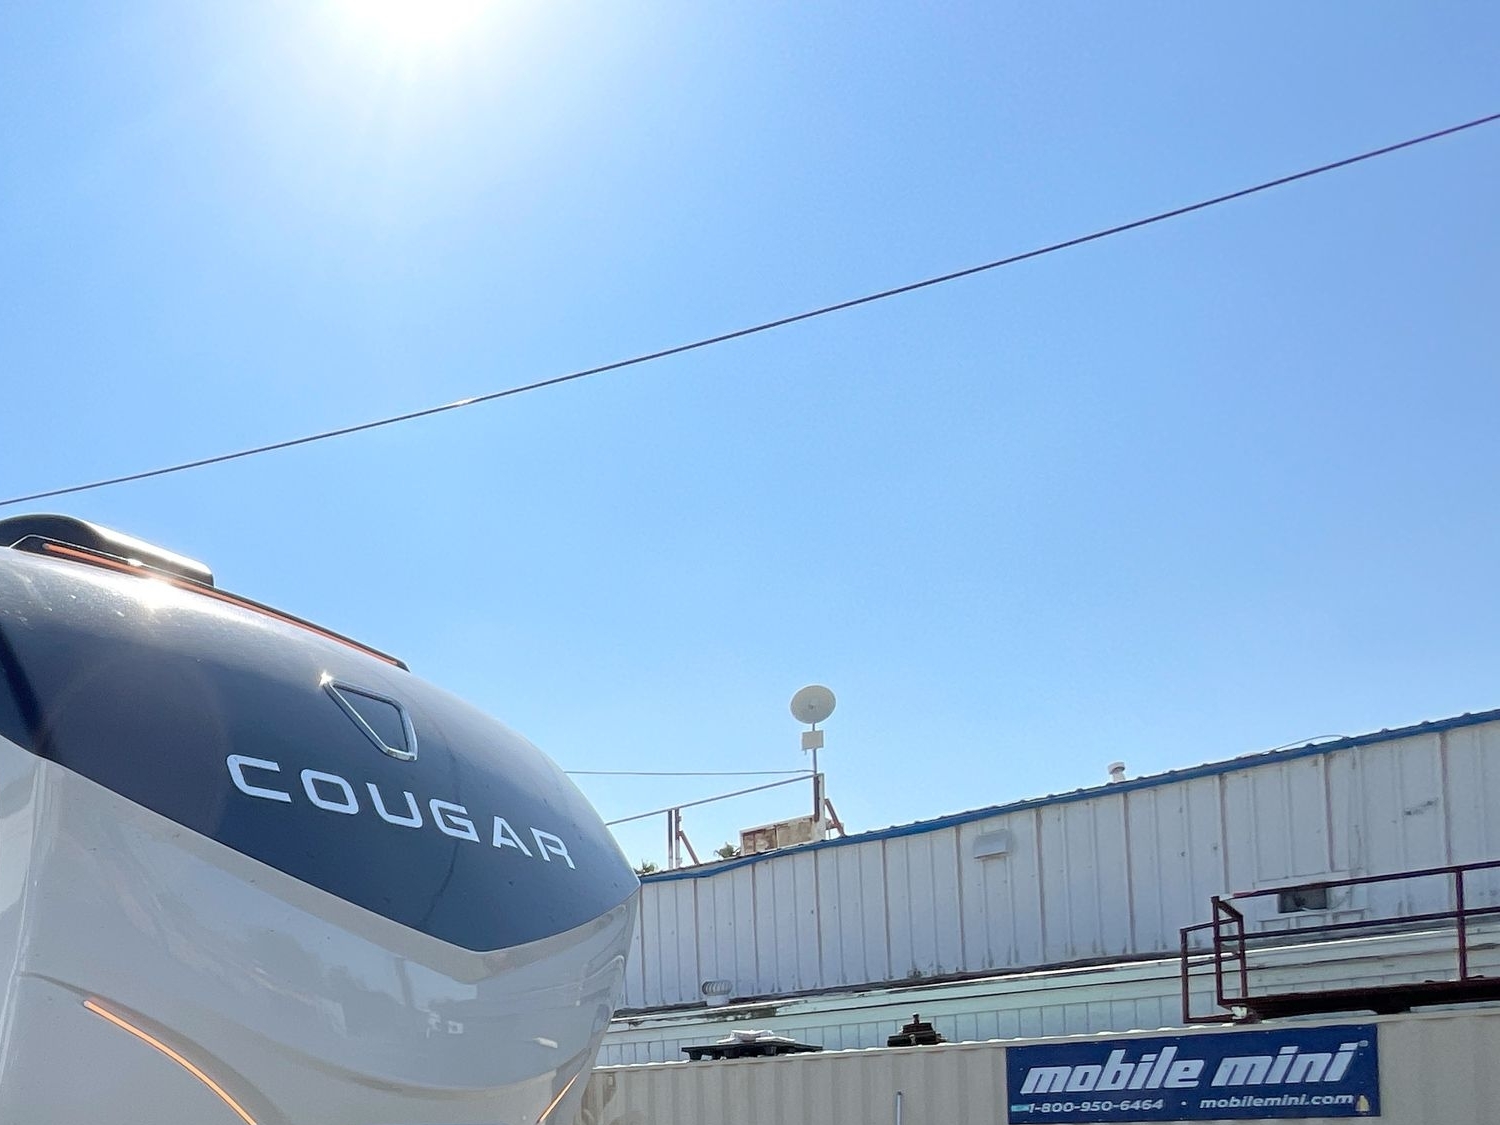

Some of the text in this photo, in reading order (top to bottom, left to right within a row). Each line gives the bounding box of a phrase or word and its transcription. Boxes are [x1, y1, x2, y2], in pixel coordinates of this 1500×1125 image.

[226, 754, 576, 870] COUGAR
[1020, 1042, 1359, 1095] mobile mini
[1028, 1093, 1354, 1113] 1-800-950-6464 mobilemini.com
